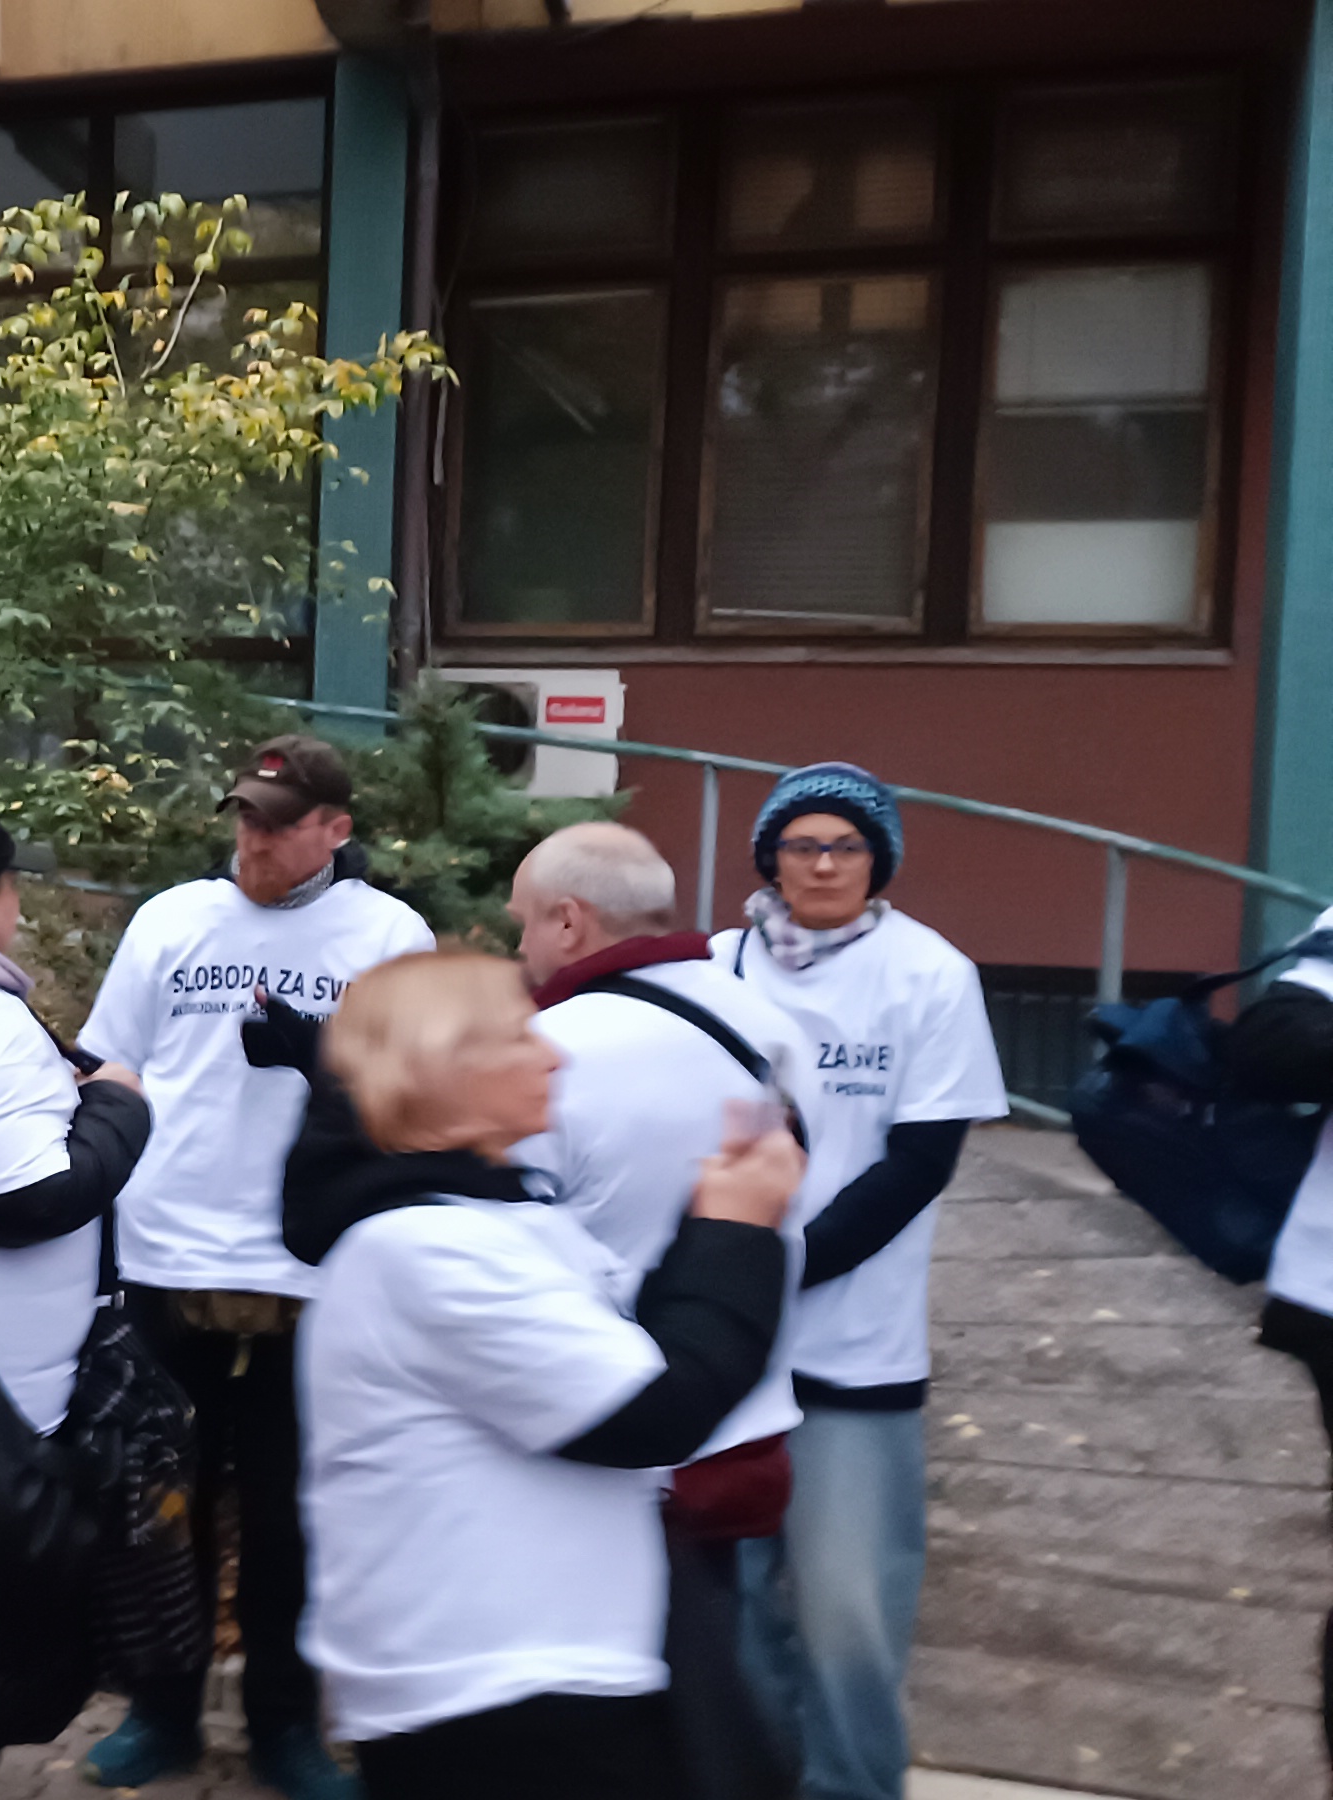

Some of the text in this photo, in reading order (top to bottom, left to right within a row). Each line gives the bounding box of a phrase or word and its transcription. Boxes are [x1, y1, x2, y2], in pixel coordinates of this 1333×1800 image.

[173, 965, 351, 1002] SLOBODA ZA SV
[818, 1042, 849, 1069] ZA
